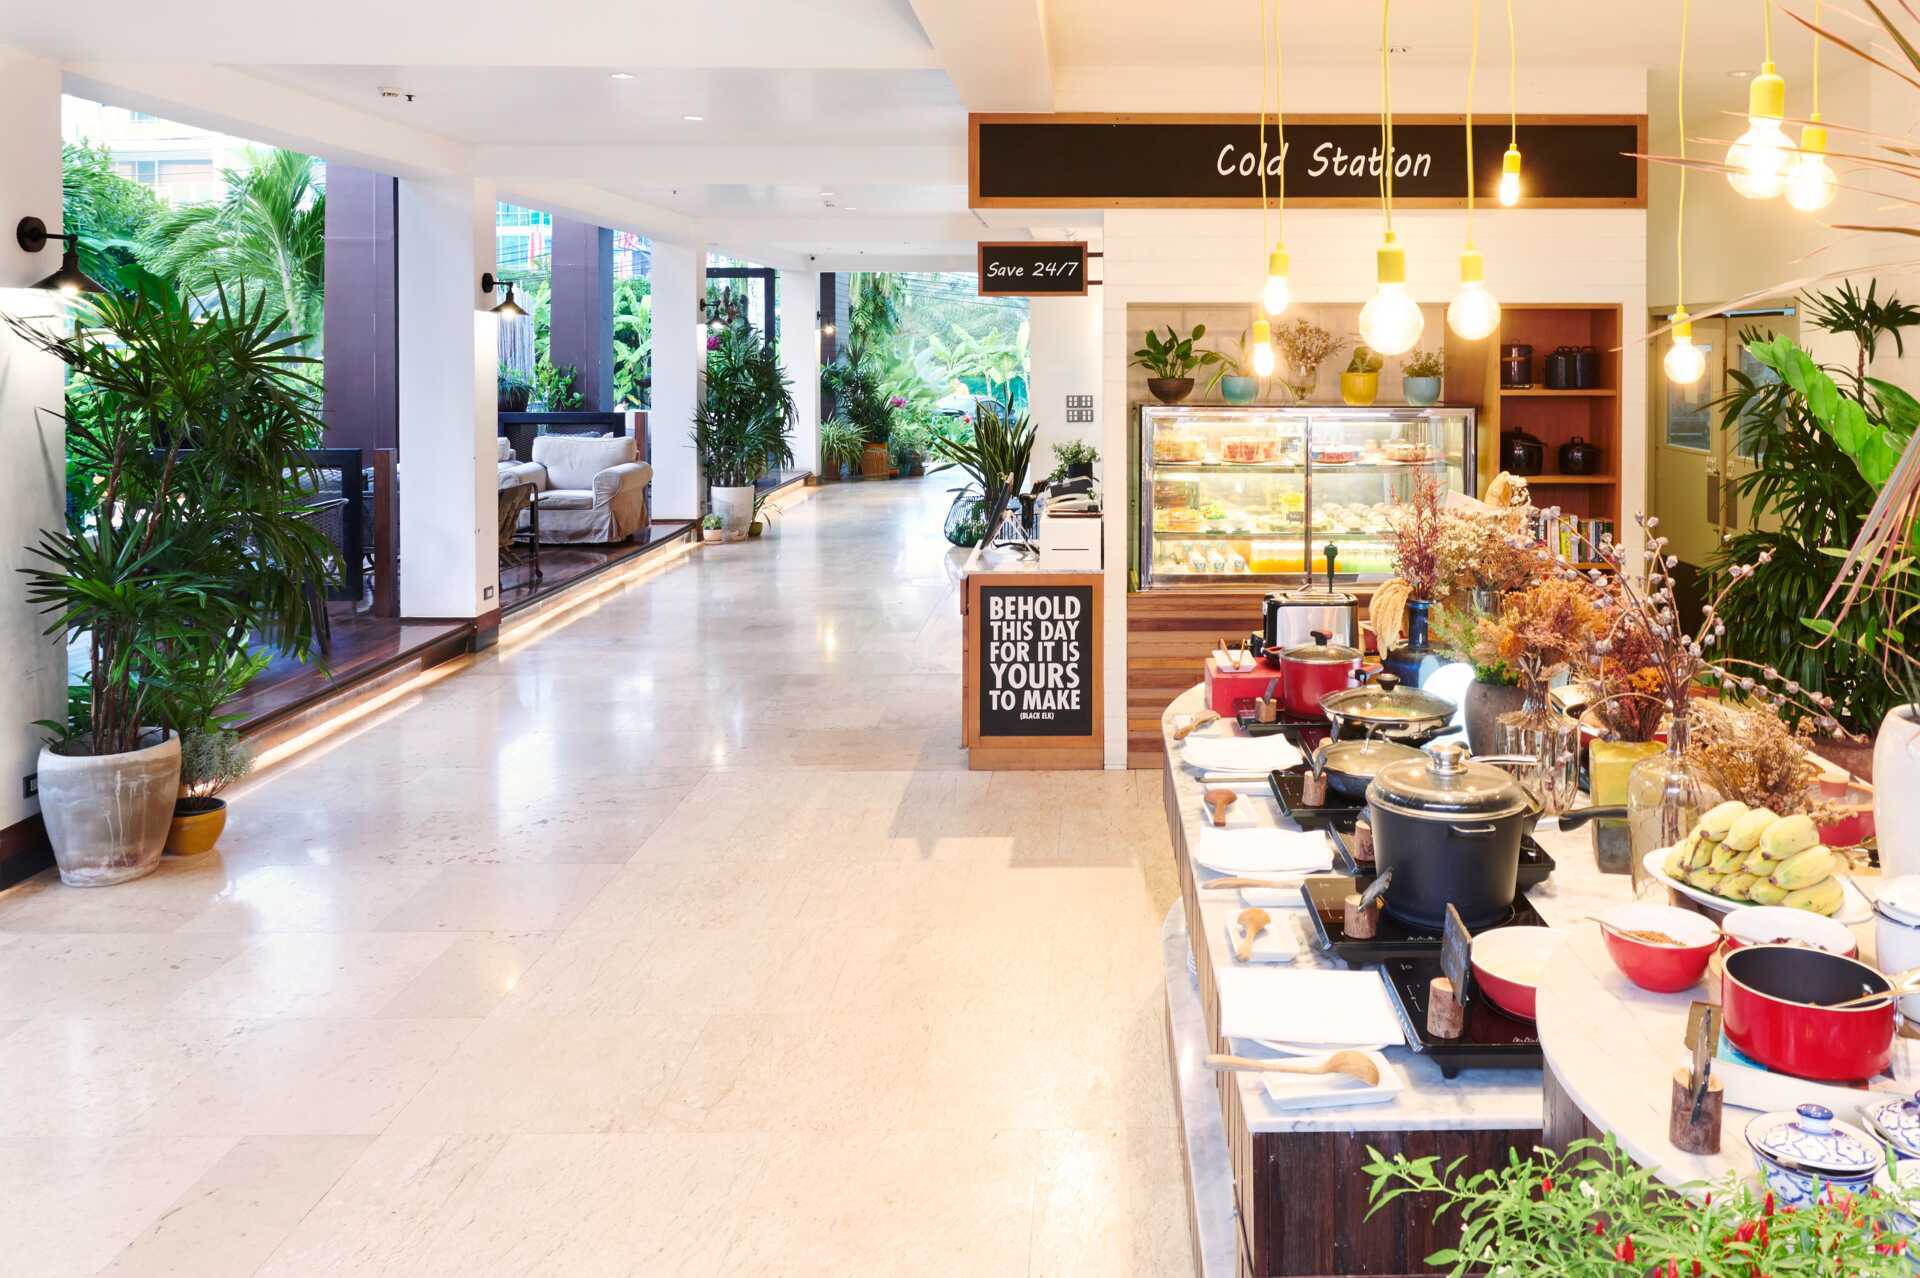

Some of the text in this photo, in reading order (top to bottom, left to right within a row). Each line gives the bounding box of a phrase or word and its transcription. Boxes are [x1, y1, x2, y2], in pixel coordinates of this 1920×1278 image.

[1216, 142, 1289, 177] Cold
[987, 261, 1079, 278] Save 24/7
[989, 596, 1081, 620] BEHOLD
[990, 621, 1080, 641] THIS DAY
[990, 641, 1080, 662] FOR IT IS
[989, 662, 1080, 689] YOURS
[988, 689, 1081, 711] TO MAKE
[1020, 712, 1055, 720] (BLACK ELK)
